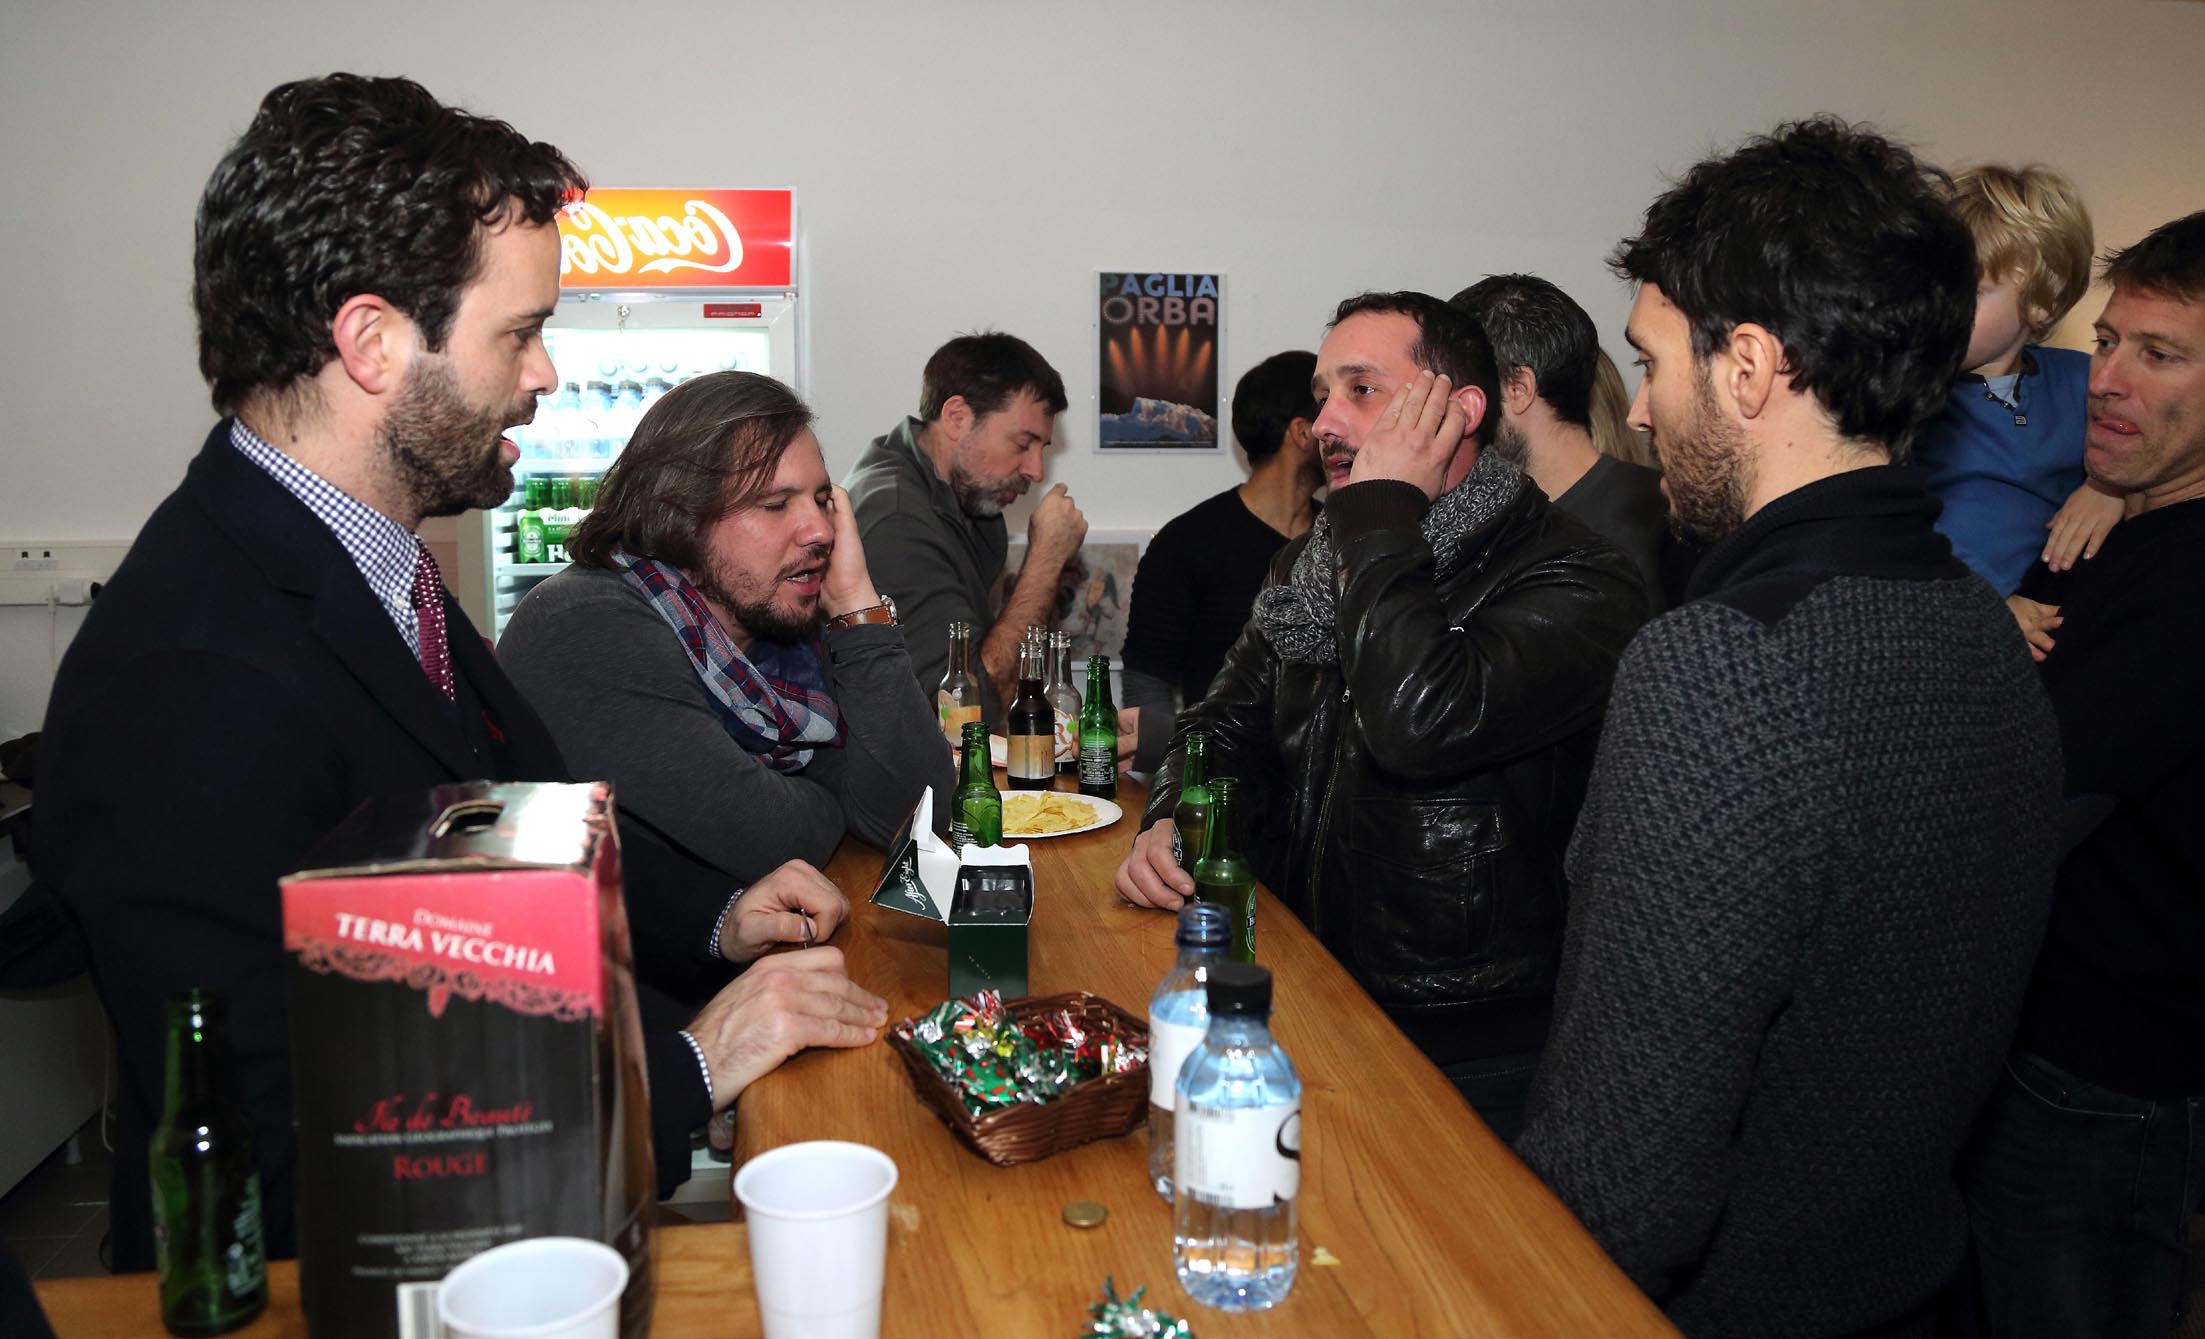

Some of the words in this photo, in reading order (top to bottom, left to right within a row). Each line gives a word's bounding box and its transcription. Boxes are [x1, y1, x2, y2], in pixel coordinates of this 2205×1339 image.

[1102, 273, 1218, 297] PAGLIA
[1103, 296, 1215, 325] ORBA
[336, 912, 423, 952] TERRA
[431, 931, 556, 975] VECCHIA
[394, 1152, 487, 1179] ROUGE
